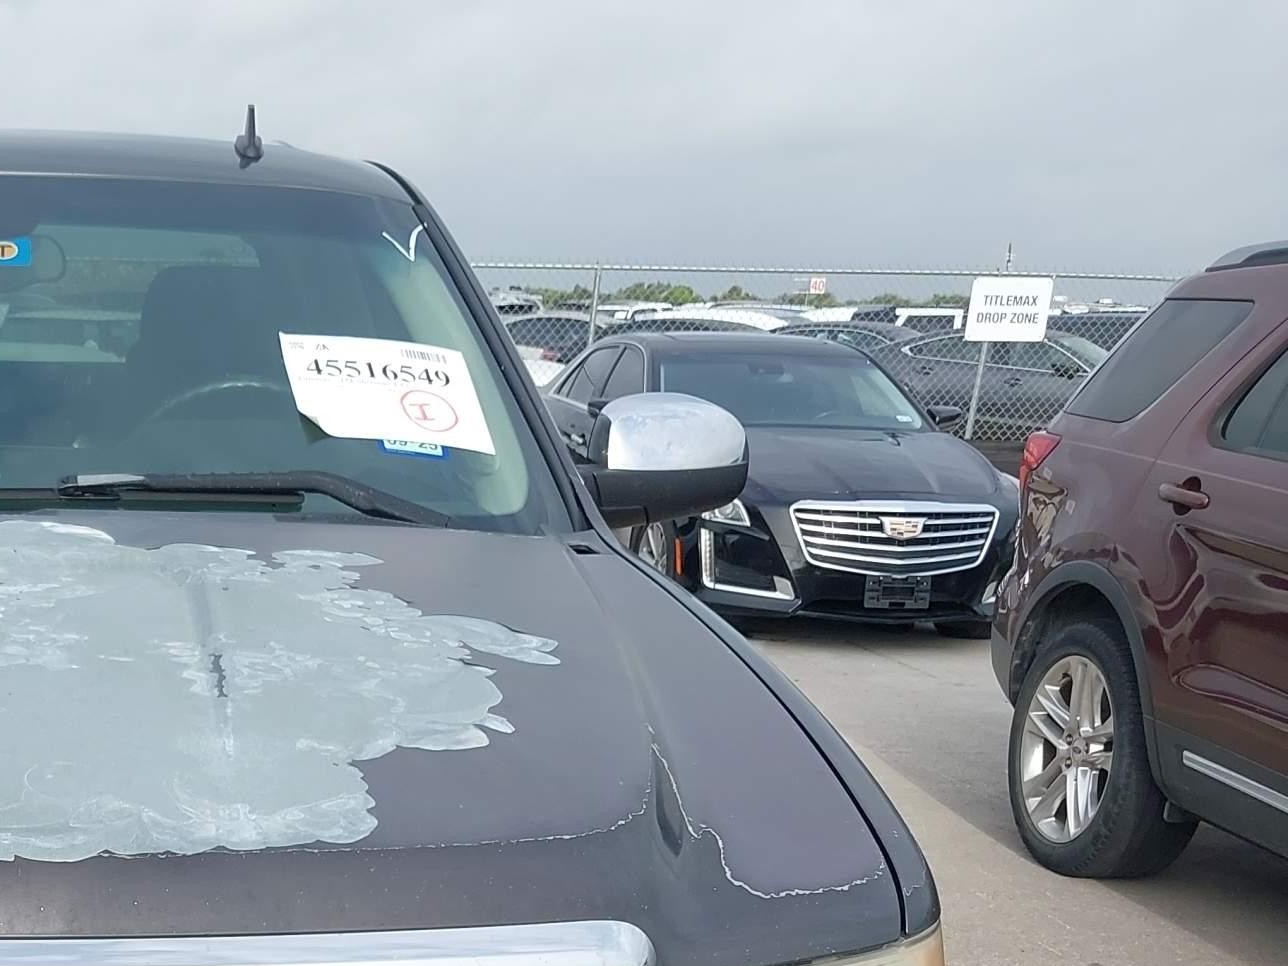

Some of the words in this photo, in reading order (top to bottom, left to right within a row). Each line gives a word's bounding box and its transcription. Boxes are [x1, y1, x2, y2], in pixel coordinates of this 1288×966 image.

[811, 280, 825, 292] 40
[984, 295, 1039, 306] TITLEMAX
[976, 312, 1007, 324] DROP
[1009, 312, 1039, 324] ZONE
[306, 358, 450, 386] 45516549
